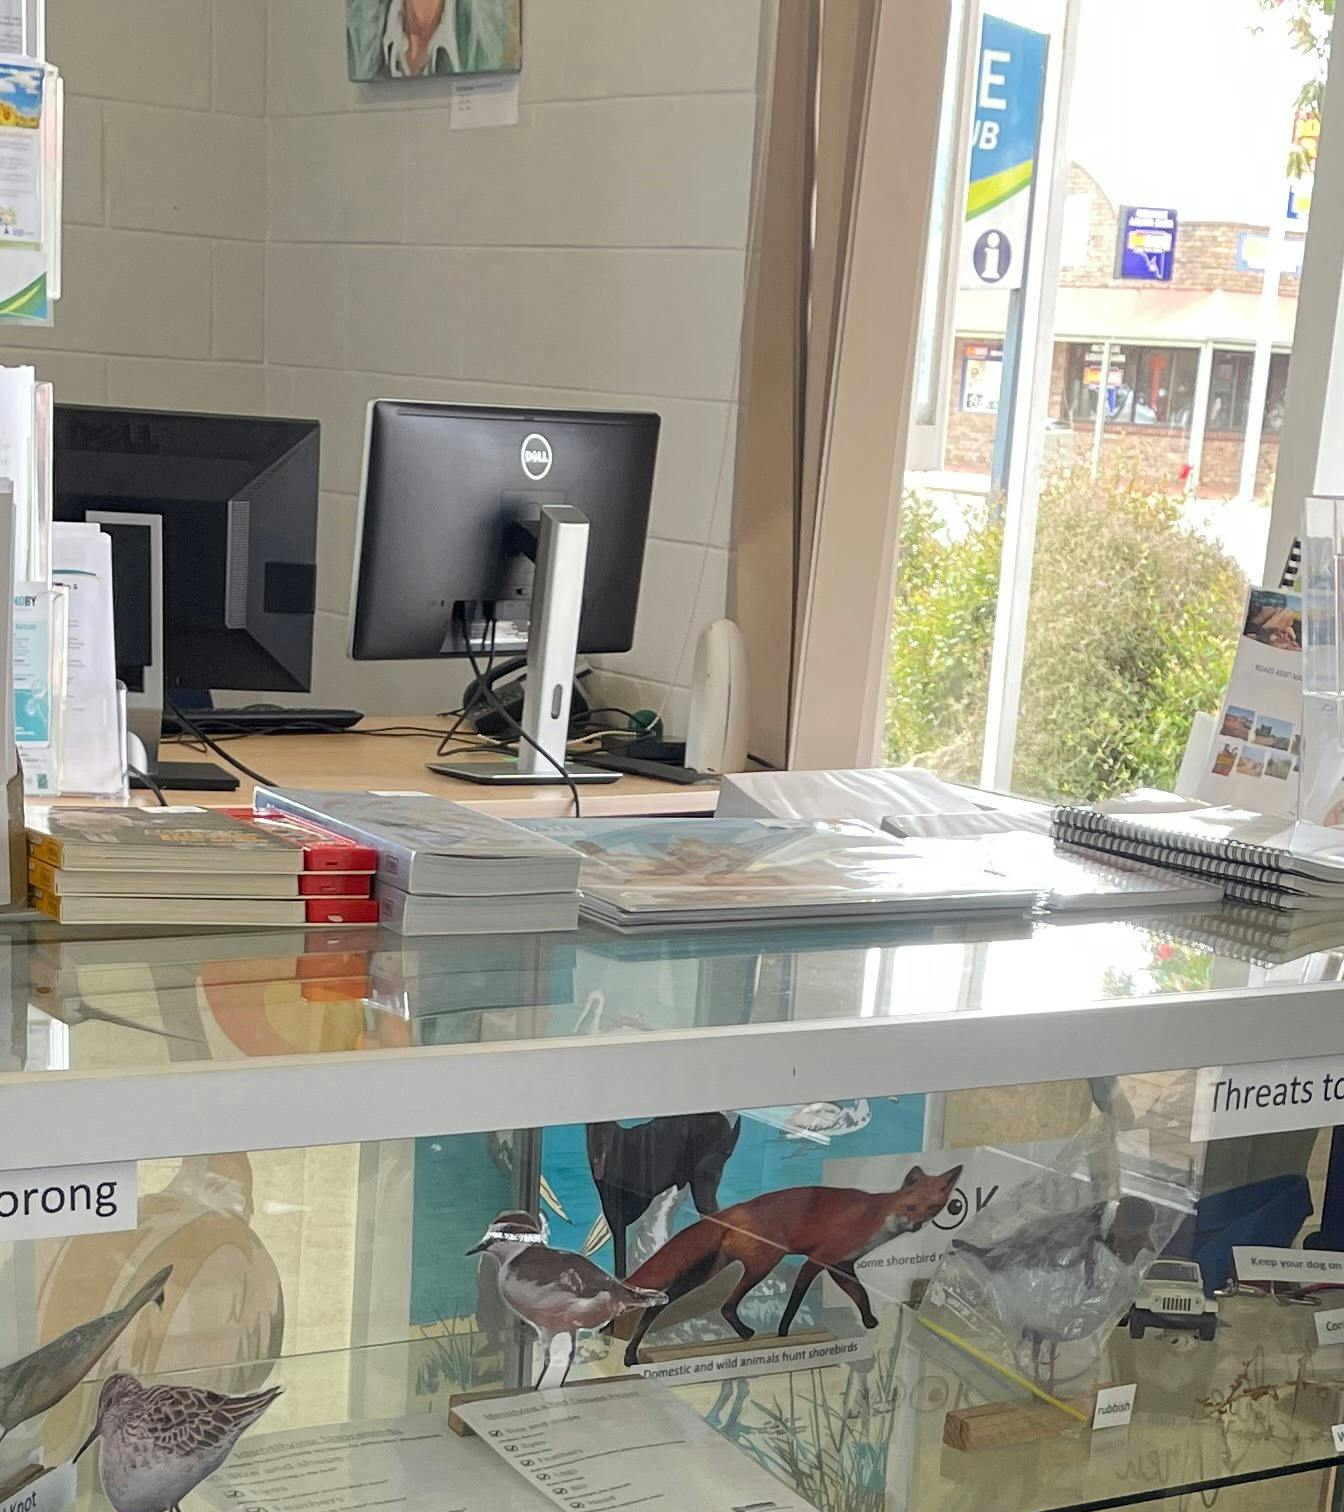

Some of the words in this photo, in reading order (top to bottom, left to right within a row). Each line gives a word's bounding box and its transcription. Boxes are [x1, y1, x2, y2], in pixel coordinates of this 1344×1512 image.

[978, 49, 1012, 110] E
[523, 449, 551, 464] DELL
[1209, 1072, 1314, 1114] Threats
[886, 1252, 937, 1267] shorebird
[1251, 1255, 1278, 1270] Keep
[1280, 1259, 1304, 1270] your
[1306, 1260, 1326, 1272] dog
[1328, 1262, 1343, 1270] on
[644, 1364, 692, 1380] Domestic
[693, 1361, 714, 1373] and
[715, 1357, 738, 1371] wild
[740, 1353, 780, 1368] animals
[781, 1350, 806, 1364] hunt
[807, 1340, 859, 1362] shorebirds
[1097, 1400, 1131, 1416] rubbish
